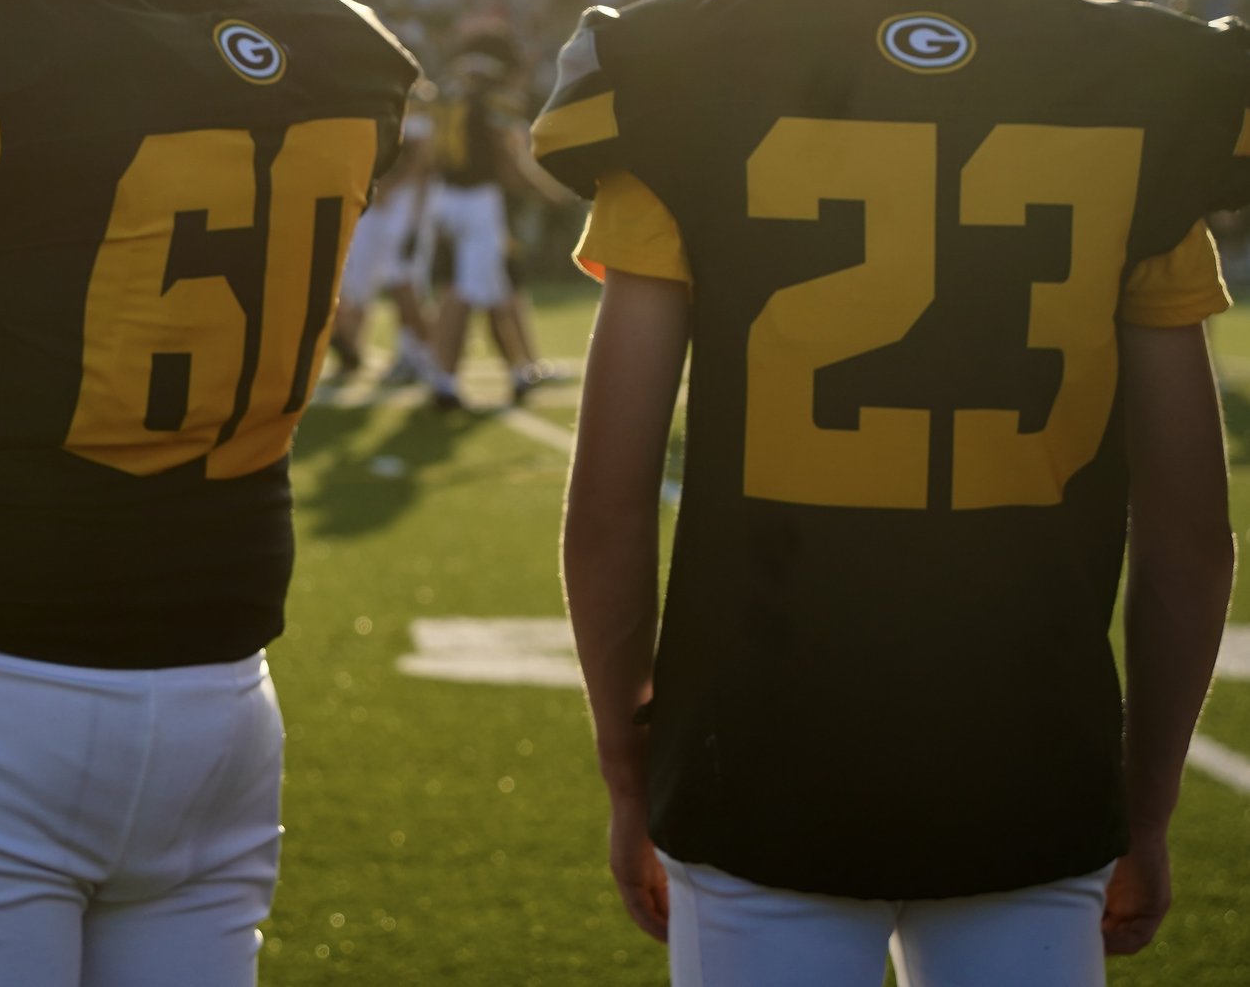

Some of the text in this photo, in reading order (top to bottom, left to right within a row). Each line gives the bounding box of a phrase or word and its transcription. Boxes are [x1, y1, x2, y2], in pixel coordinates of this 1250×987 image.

[222, 27, 278, 76] G
[888, 19, 966, 65] G
[64, 118, 377, 479] 60
[744, 117, 1144, 509] 23
